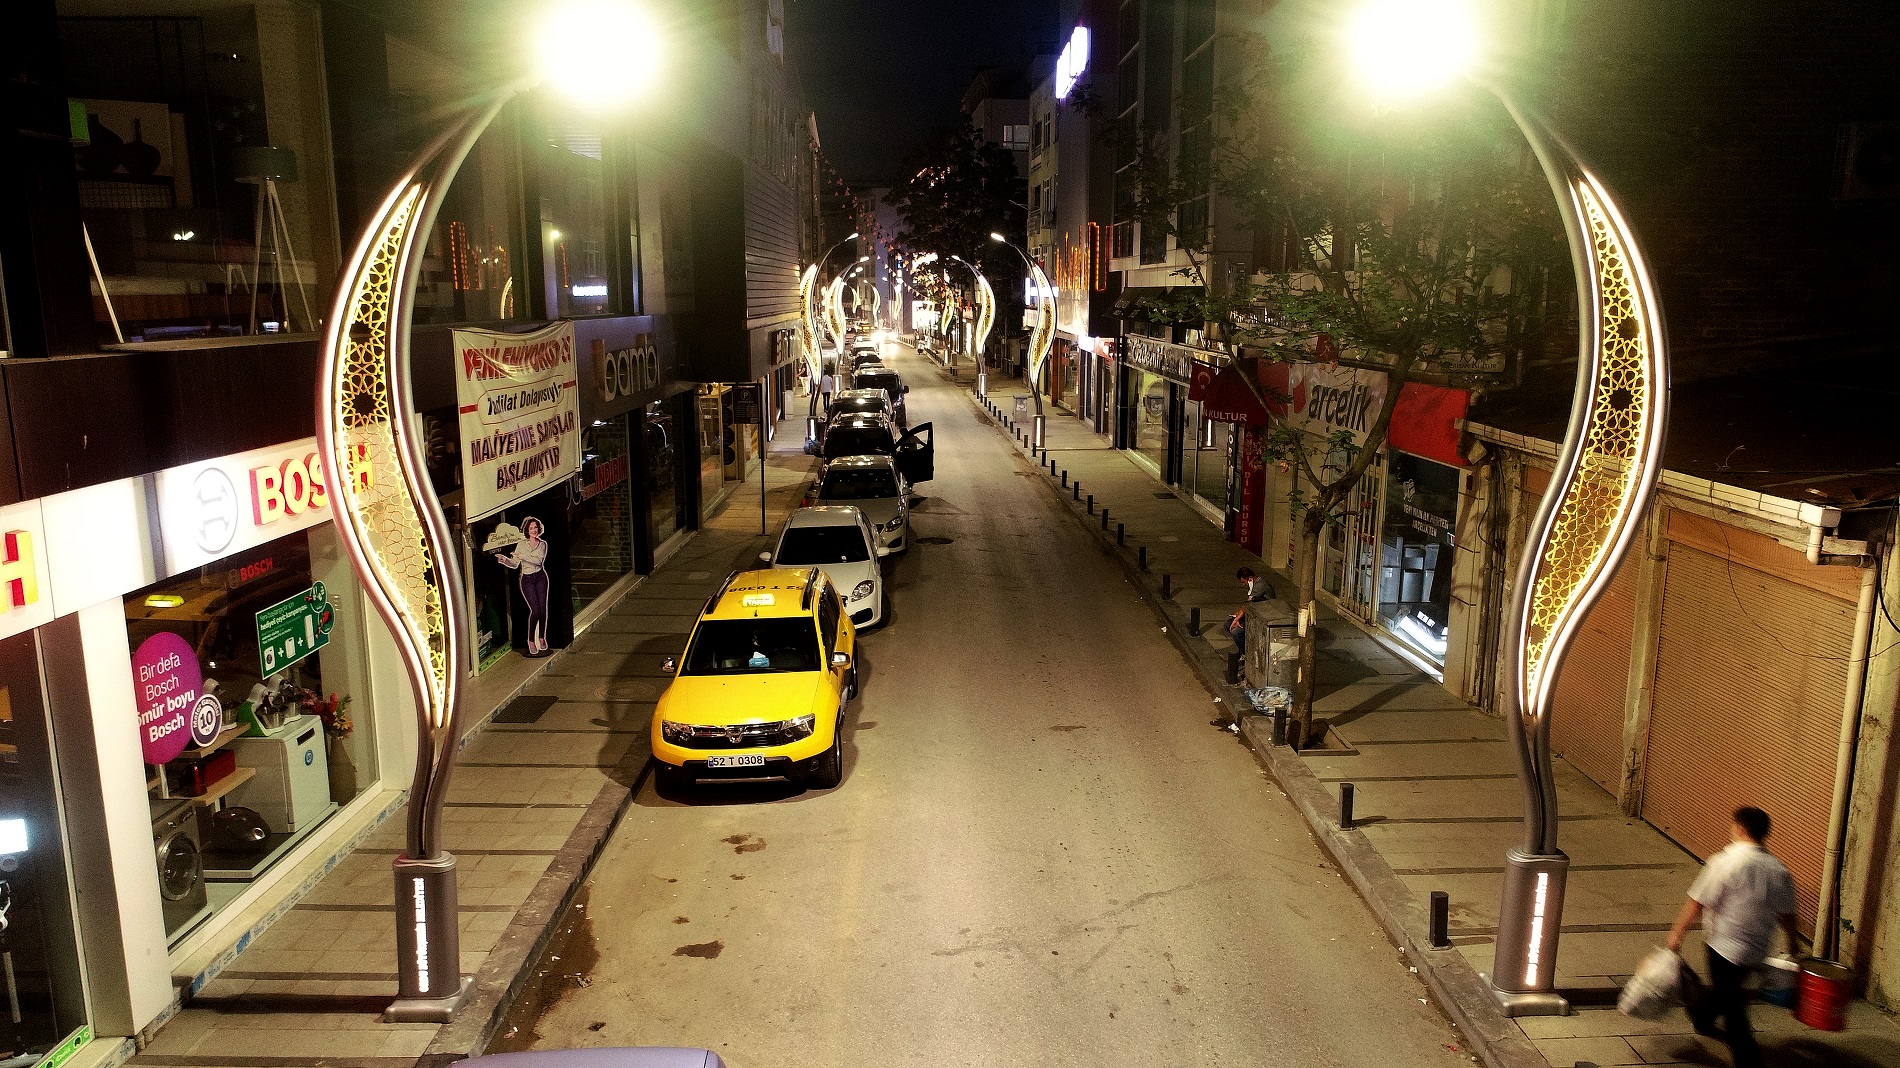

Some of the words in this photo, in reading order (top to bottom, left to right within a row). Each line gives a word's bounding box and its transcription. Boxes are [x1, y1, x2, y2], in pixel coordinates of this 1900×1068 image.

[1308, 384, 1373, 433] arçelik
[496, 445, 561, 491] BAŞLAMIŞTIR
[249, 443, 374, 525] BOSH
[240, 557, 273, 582] BOSCH
[140, 663, 156, 682] Bir
[157, 652, 181, 675] defa
[145, 673, 179, 701] Bosch
[166, 689, 195, 713] boyu
[149, 712, 185, 743] Bosch
[201, 710, 213, 729] 10
[713, 757, 725, 766] 52
[729, 756, 734, 766] T
[738, 755, 763, 765] 0308
